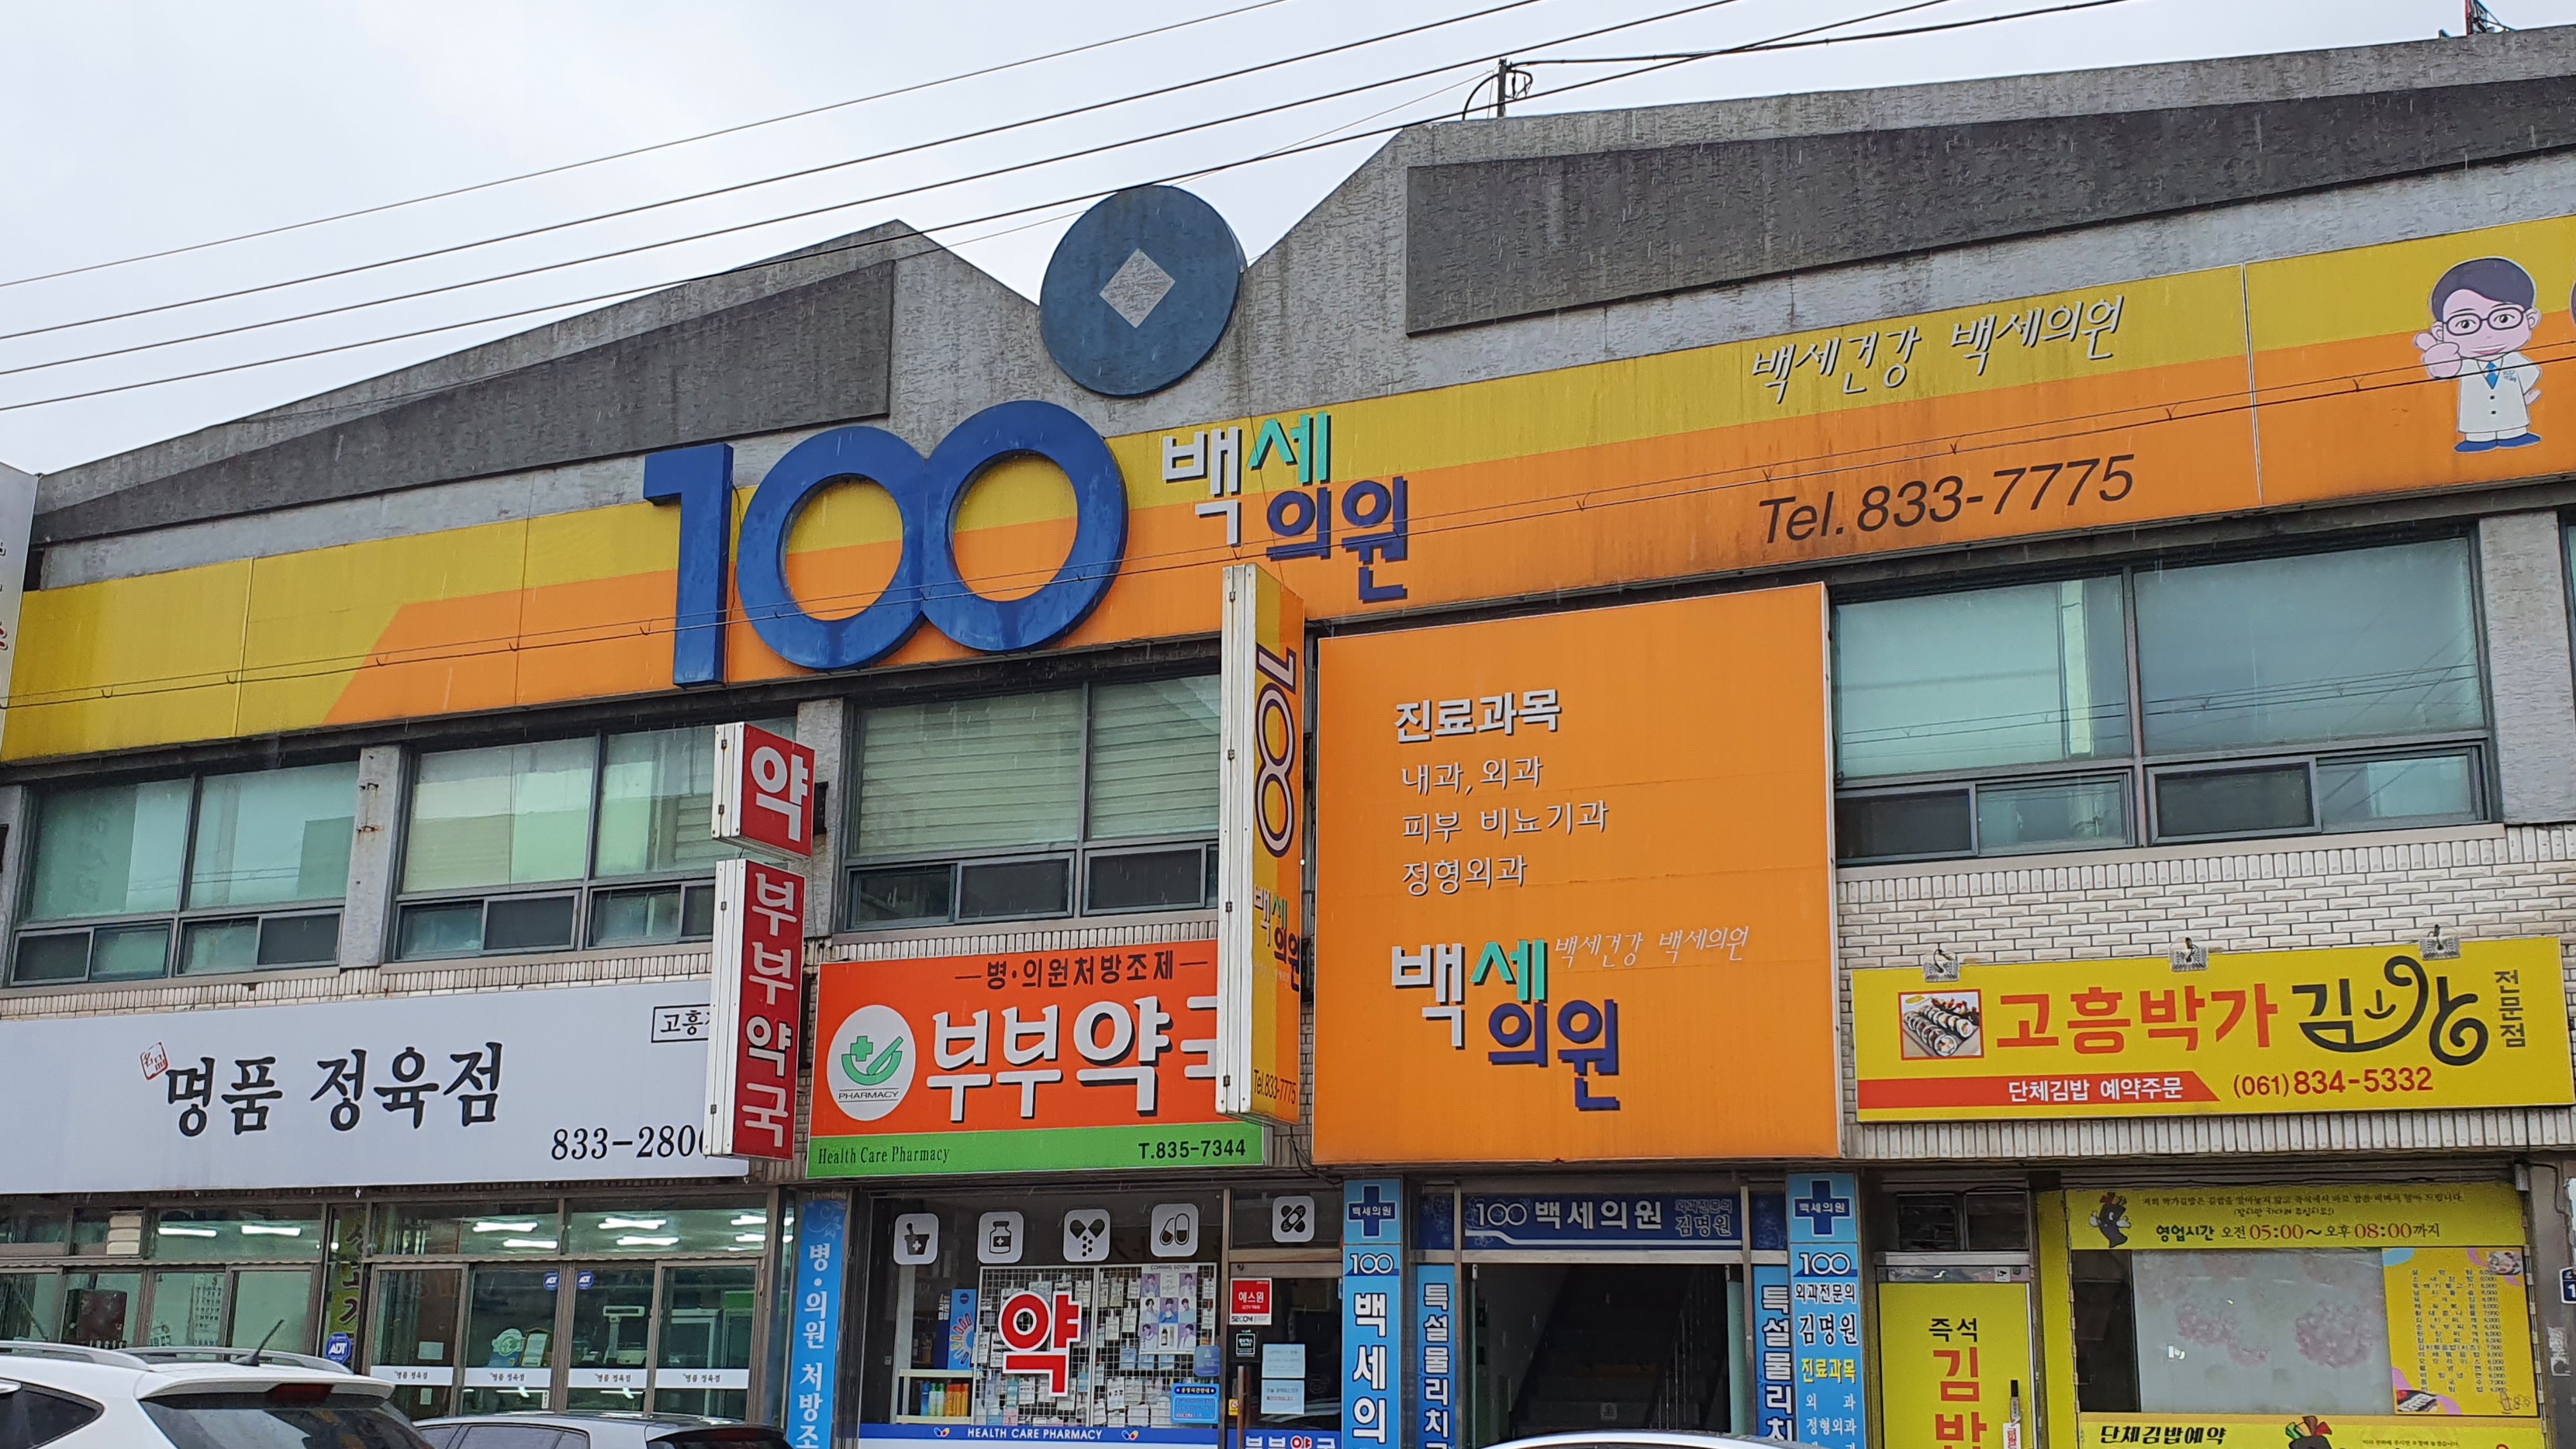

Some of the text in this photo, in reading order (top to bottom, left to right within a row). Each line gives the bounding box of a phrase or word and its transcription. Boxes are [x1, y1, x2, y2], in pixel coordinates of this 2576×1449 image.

[1752, 295, 2124, 404] 백세건강 백세의원
[644, 399, 1129, 688] 100
[1395, 689, 1562, 744] 진료과목
[751, 745, 808, 842] 약
[1401, 800, 1610, 844] 피부 비뇨기과
[1401, 855, 1528, 896] 정형외과
[1555, 926, 1749, 969] 백세건강 백세의원
[741, 873, 796, 1147] 부부약국
[1995, 982, 2277, 1053] 고흥박가
[2493, 968, 2528, 1050] 전문점
[661, 1012, 709, 1036] 고흥
[165, 1042, 503, 1137] 명품 정육점
[838, 1089, 899, 1101] PHARMACY
[2008, 1074, 2184, 1103] 단체김밥 예약주문
[818, 1144, 950, 1166] Health Care Pharmacy
[1138, 1139, 1246, 1160] T.835-7344
[1352, 1205, 1392, 1217] 백세의원
[1535, 1200, 1661, 1230] 백세의원
[1798, 1202, 1846, 1214] 백세의원
[1675, 1214, 1732, 1237] 김명원
[2156, 1224, 2214, 1242] 영업시간
[1795, 1282, 1856, 1305] 외과전문의
[998, 1291, 1082, 1396] 약
[1797, 1313, 1859, 1347] 김명원
[1929, 1317, 1978, 1343] 즉석
[329, 1342, 347, 1354] ADT
[1424, 1284, 1449, 1449] 특설물리치
[1801, 1358, 1856, 1385] 진료과목
[968, 1427, 1103, 1440] HEALTH CARE PHARMACY
[1806, 1416, 1857, 1436] 정형외과
[2100, 1426, 2227, 1446] 단체김밥예약
